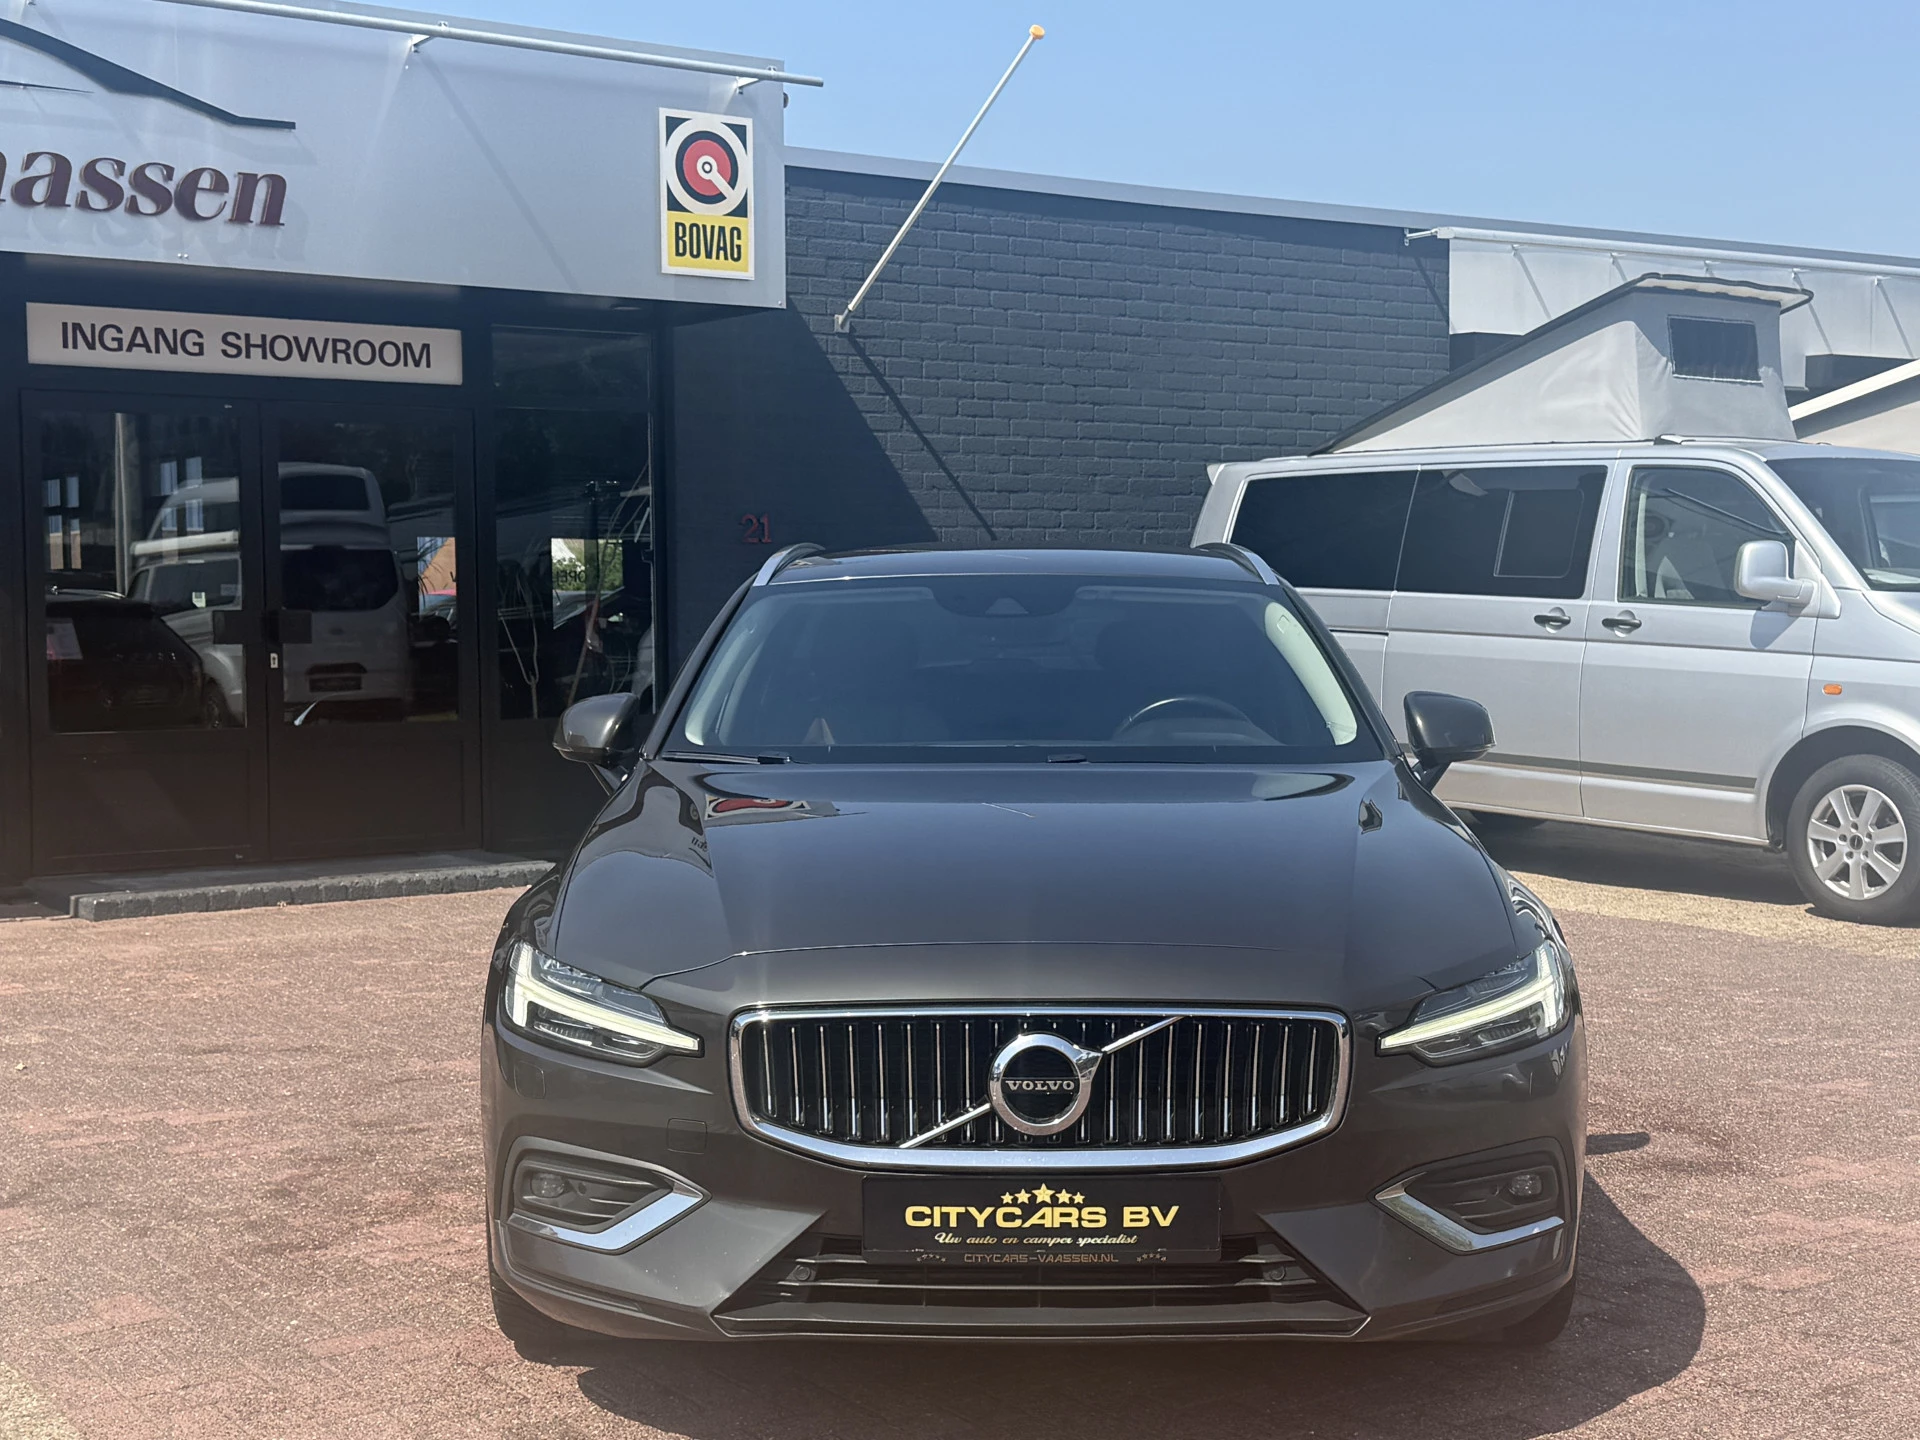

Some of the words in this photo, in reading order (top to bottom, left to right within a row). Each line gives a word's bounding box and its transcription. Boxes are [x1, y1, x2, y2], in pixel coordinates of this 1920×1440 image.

[0, 150, 287, 226] assen
[674, 222, 742, 262] BOVAG
[61, 322, 205, 357] INGANG
[220, 331, 432, 369] SHOWROOM
[741, 513, 772, 543] 21
[1005, 1080, 1075, 1091] VOLVO
[905, 1205, 1107, 1228] CITYCARS
[1123, 1205, 1180, 1228] BV
[935, 1232, 962, 1244] Uw
[966, 1235, 998, 1244] auto
[1023, 1236, 1074, 1247] camper
[1076, 1234, 1138, 1248] specialist
[964, 1253, 1119, 1263] CITYCARS-VAASSEN.NL
